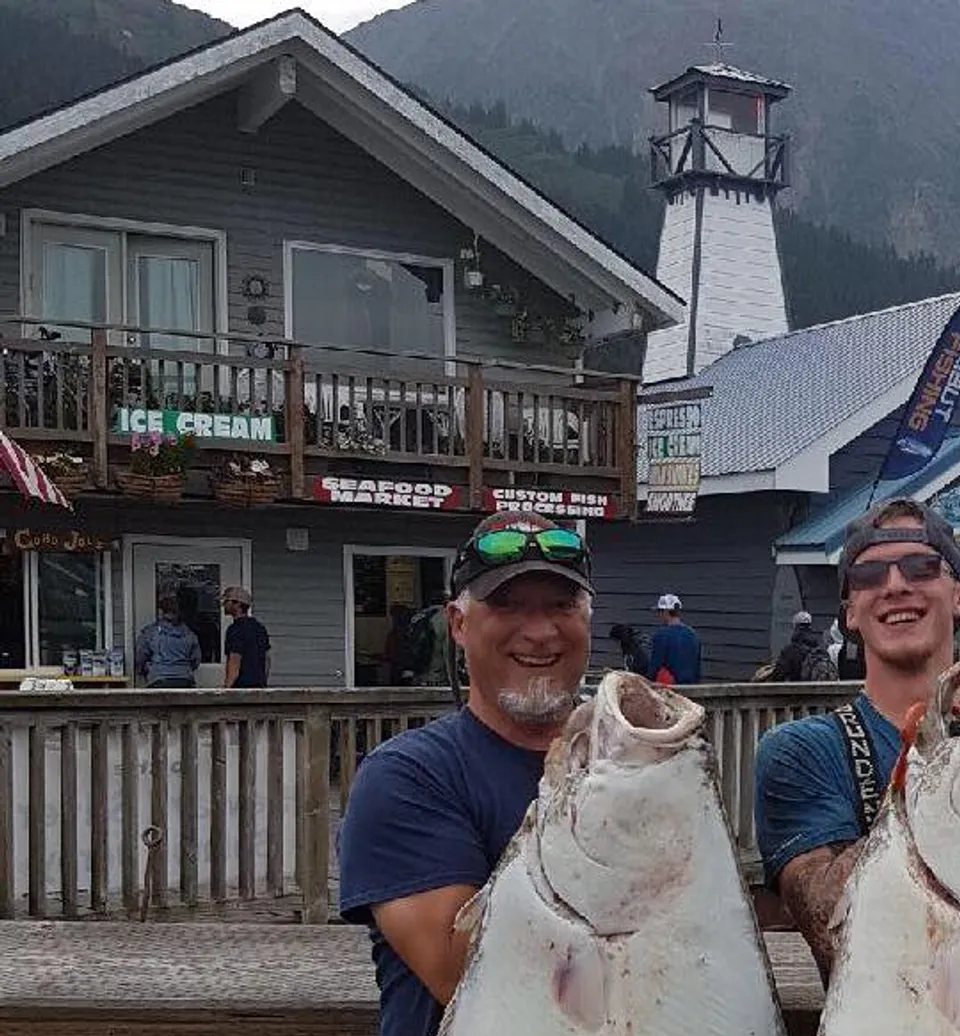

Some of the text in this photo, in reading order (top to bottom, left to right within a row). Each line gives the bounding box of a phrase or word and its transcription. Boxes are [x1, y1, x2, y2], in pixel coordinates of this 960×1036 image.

[120, 408, 272, 441] ICE CREAM
[322, 476, 453, 497] SEAFOOD
[330, 490, 445, 508] MARKET
[492, 488, 608, 506] CUSTOM FISH
[496, 501, 605, 517] PROCESSING
